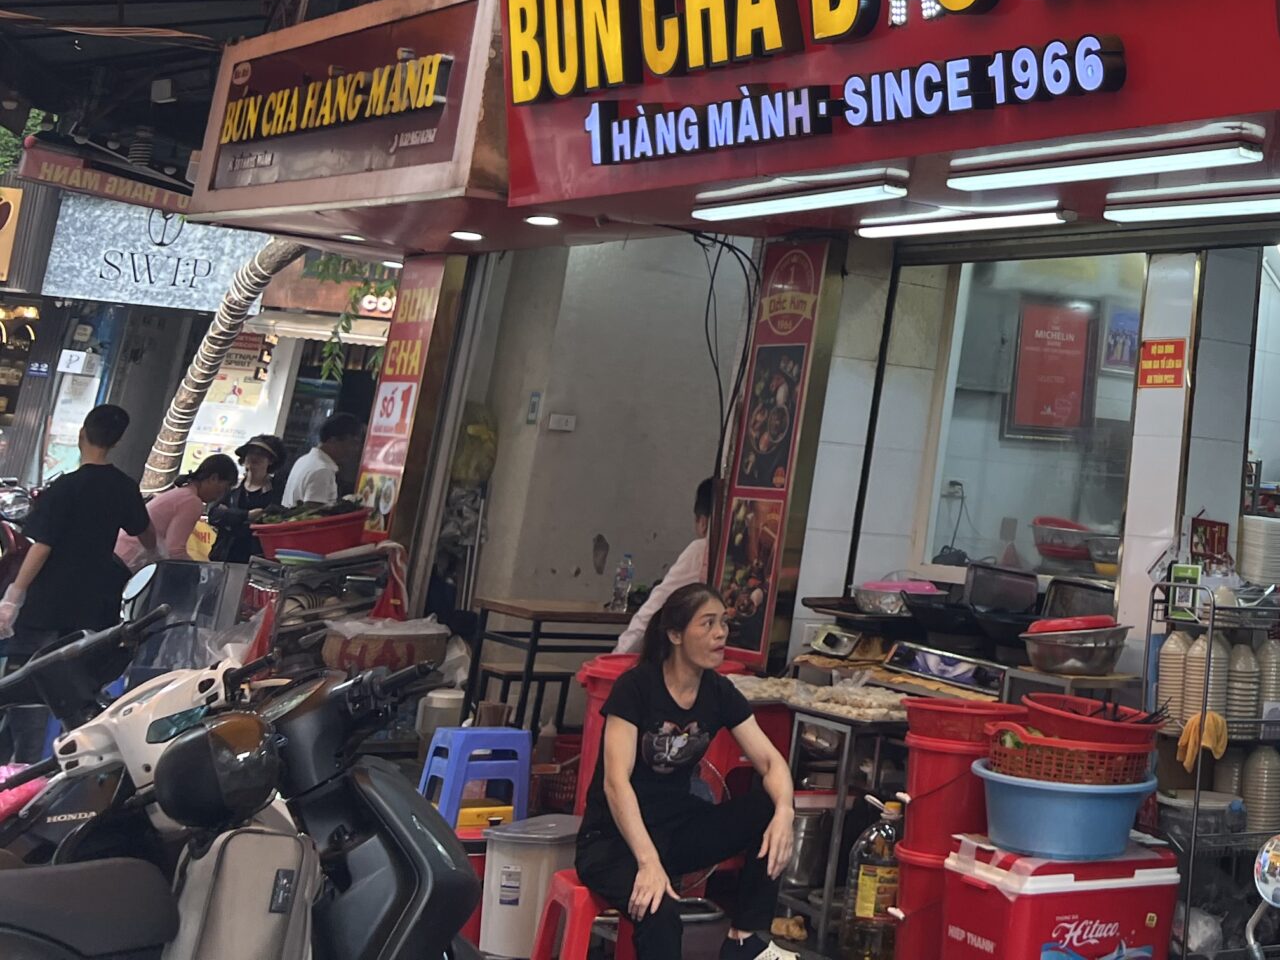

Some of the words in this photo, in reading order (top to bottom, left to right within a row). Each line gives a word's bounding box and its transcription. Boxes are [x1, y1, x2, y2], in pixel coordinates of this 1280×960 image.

[301, 64, 365, 130] HÀNG
[365, 48, 442, 118] MÀNH
[584, 101, 602, 165] 1
[611, 103, 699, 163] HÀNG
[707, 85, 811, 147] MÀNH
[843, 58, 972, 127] SINCE
[987, 36, 1103, 105] 1966
[1034, 328, 1076, 342] MICHELIN
[30, 362, 49, 372] 22
[395, 385, 413, 435] 1
[46, 811, 97, 824] HONDA
